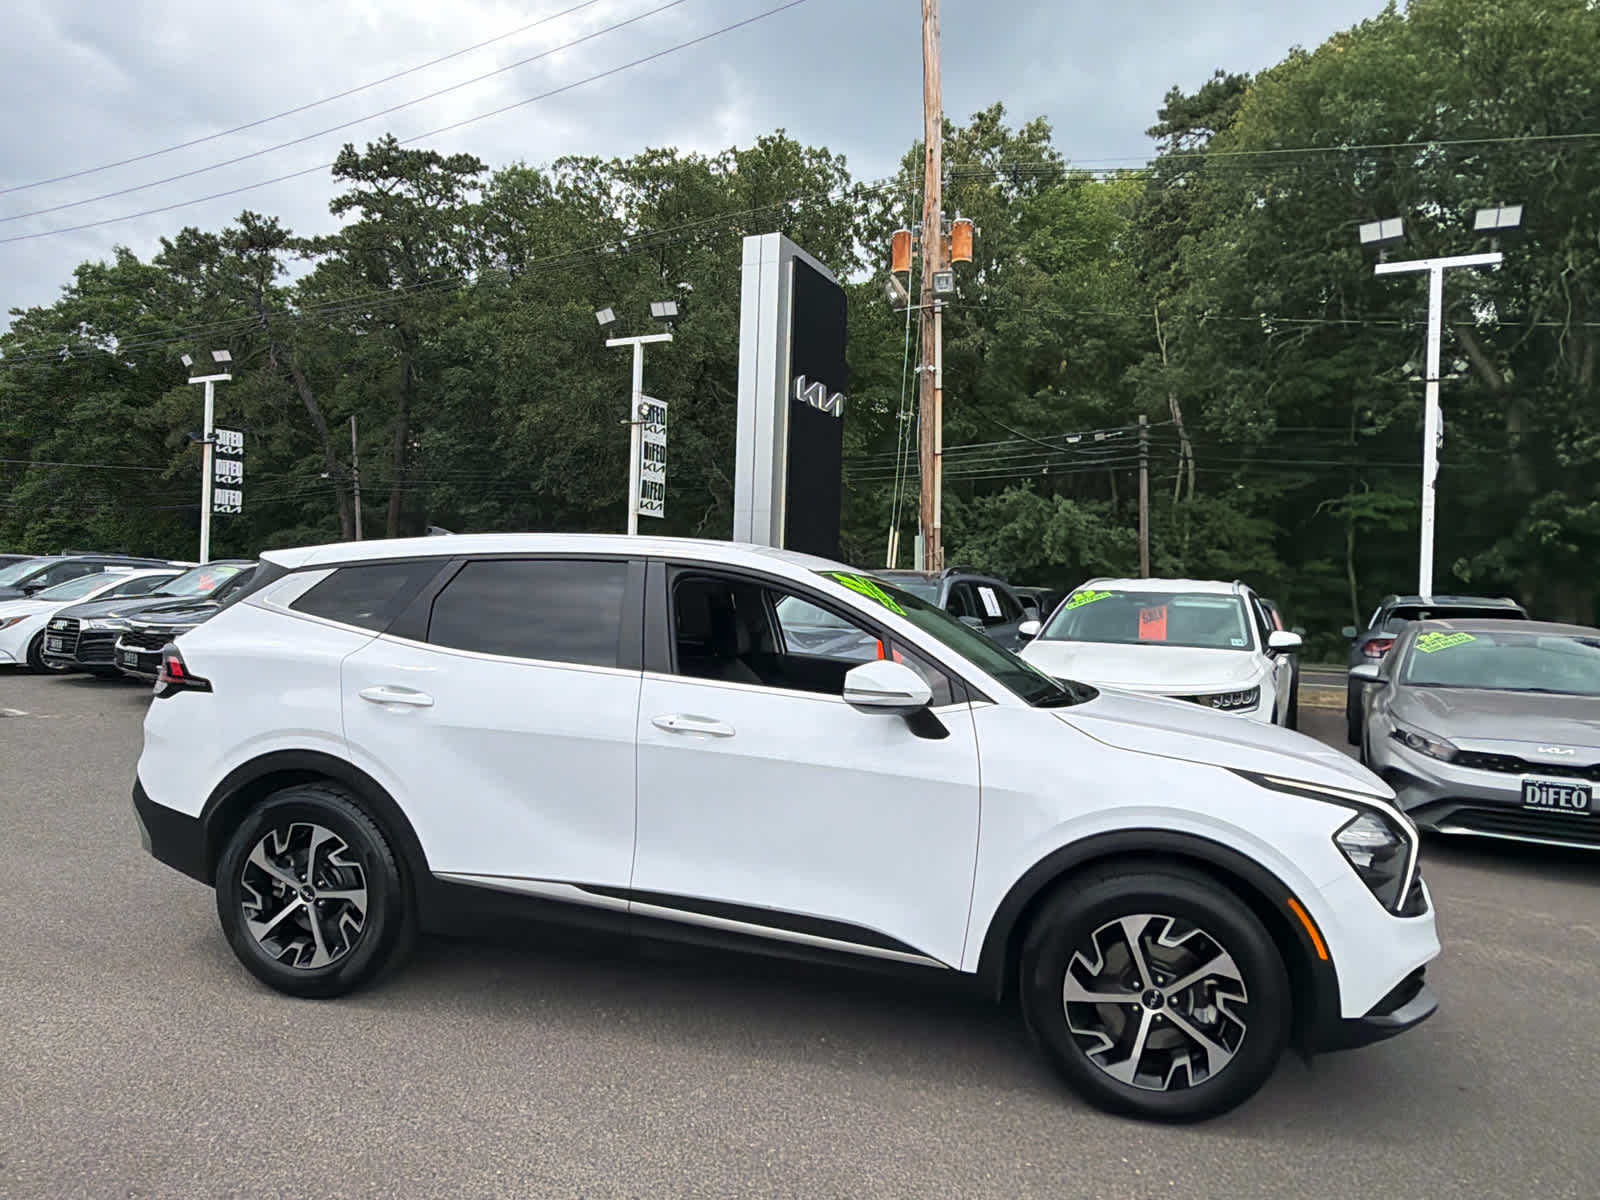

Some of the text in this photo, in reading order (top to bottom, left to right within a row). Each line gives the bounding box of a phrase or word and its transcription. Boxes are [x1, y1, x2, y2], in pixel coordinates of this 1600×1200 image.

[793, 375, 844, 418] KIA
[643, 461, 665, 473] KIA
[640, 500, 663, 511] KIA
[1526, 785, 1588, 809] DiFEO
